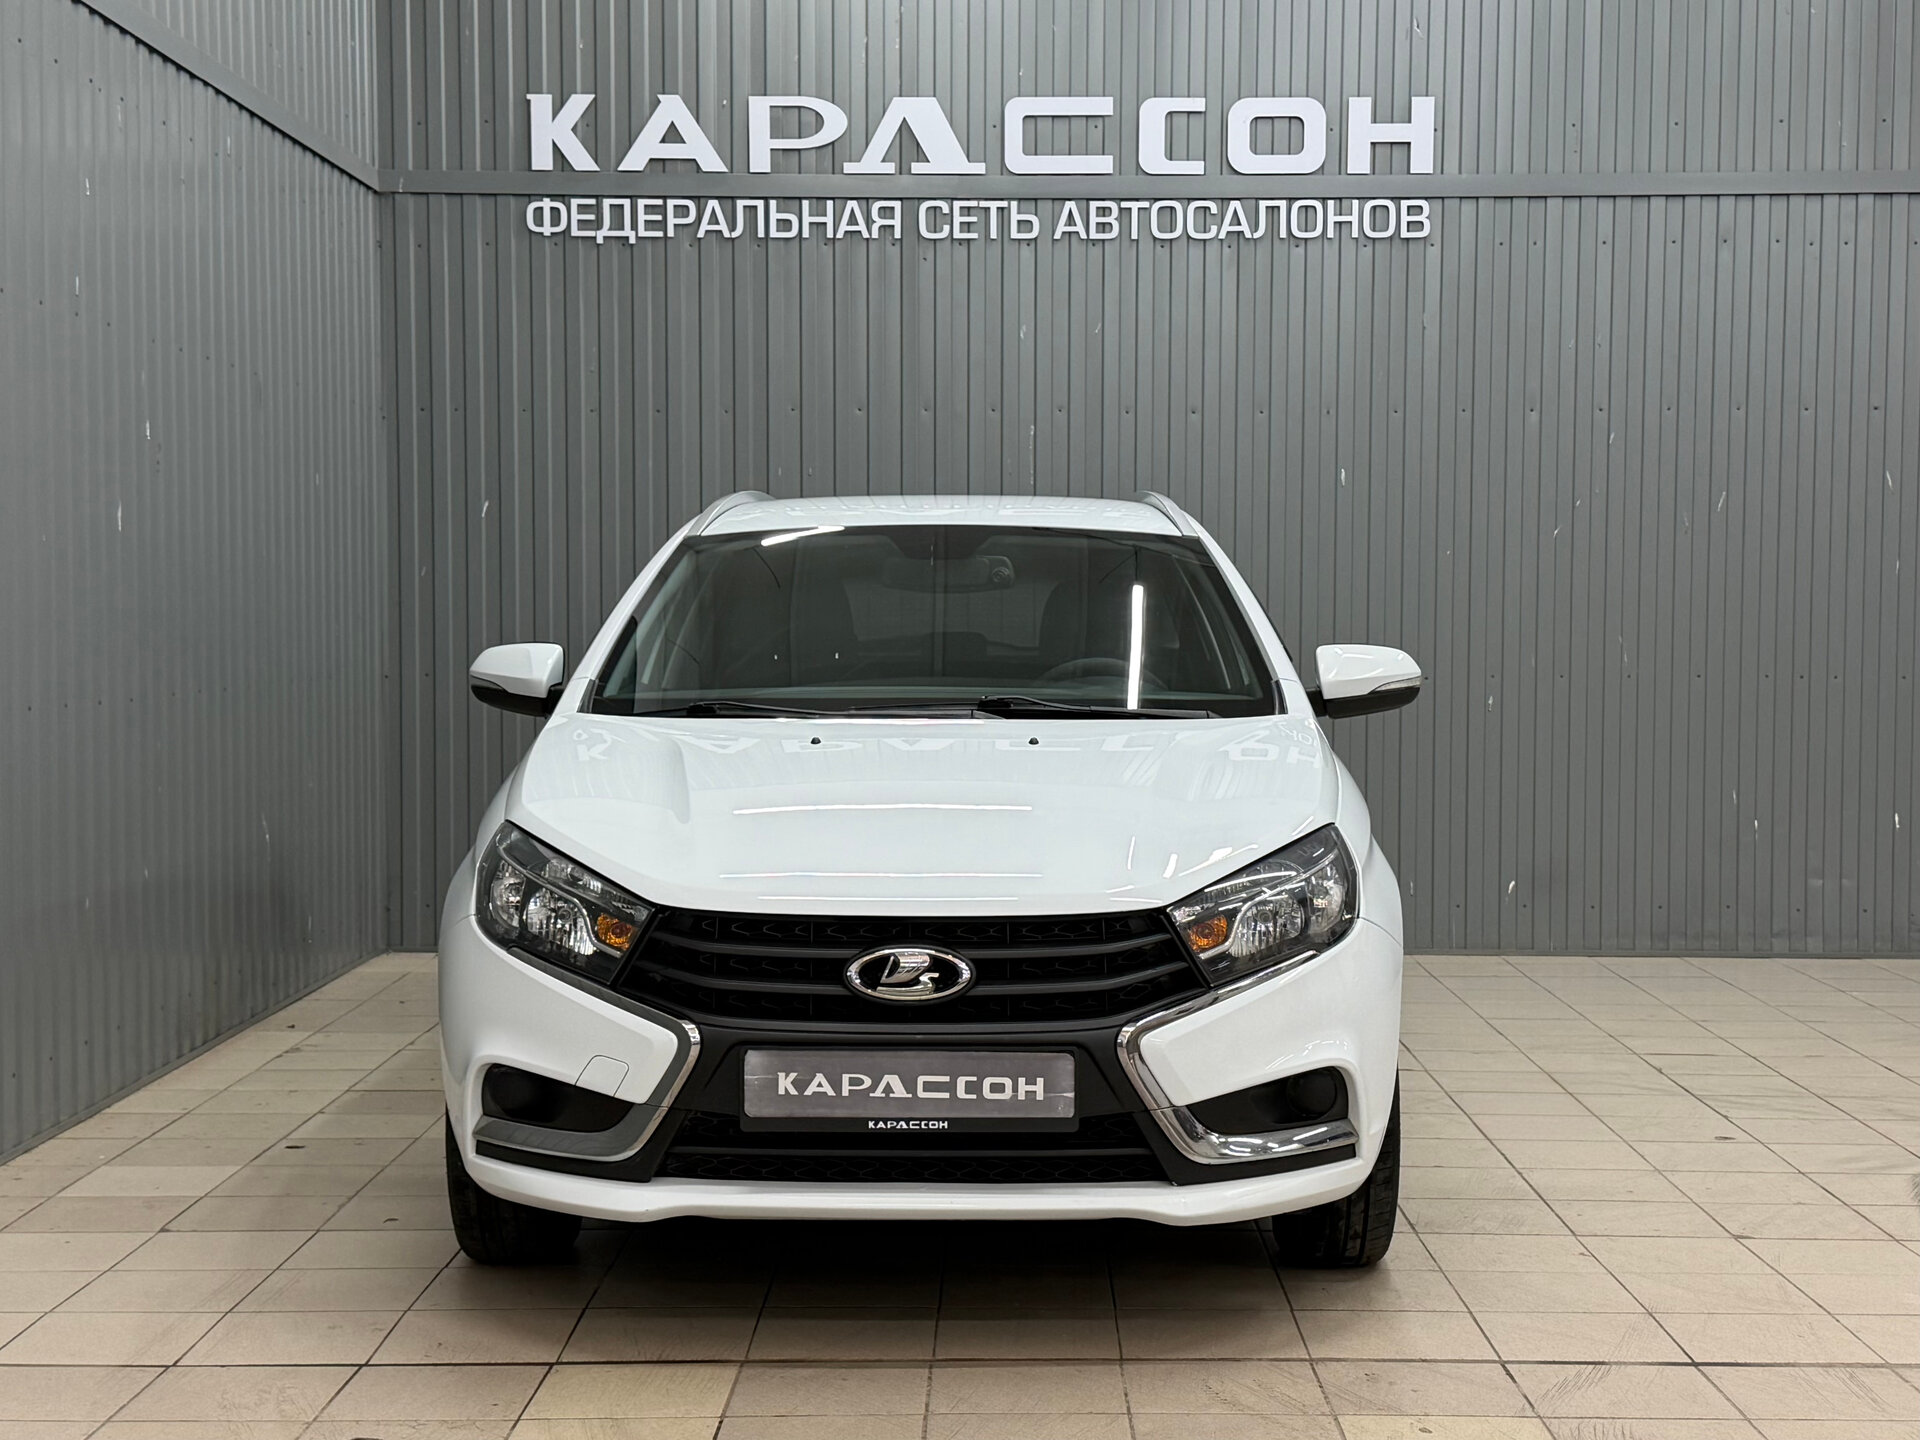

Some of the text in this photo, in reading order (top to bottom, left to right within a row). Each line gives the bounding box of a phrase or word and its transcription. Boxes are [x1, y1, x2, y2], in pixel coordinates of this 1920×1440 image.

[526, 94, 1435, 174] КАРАССОН
[525, 197, 1431, 244] ФЕДЕРАЛЬНАЯ СЕТЬ АВТОСАЛОНОВ
